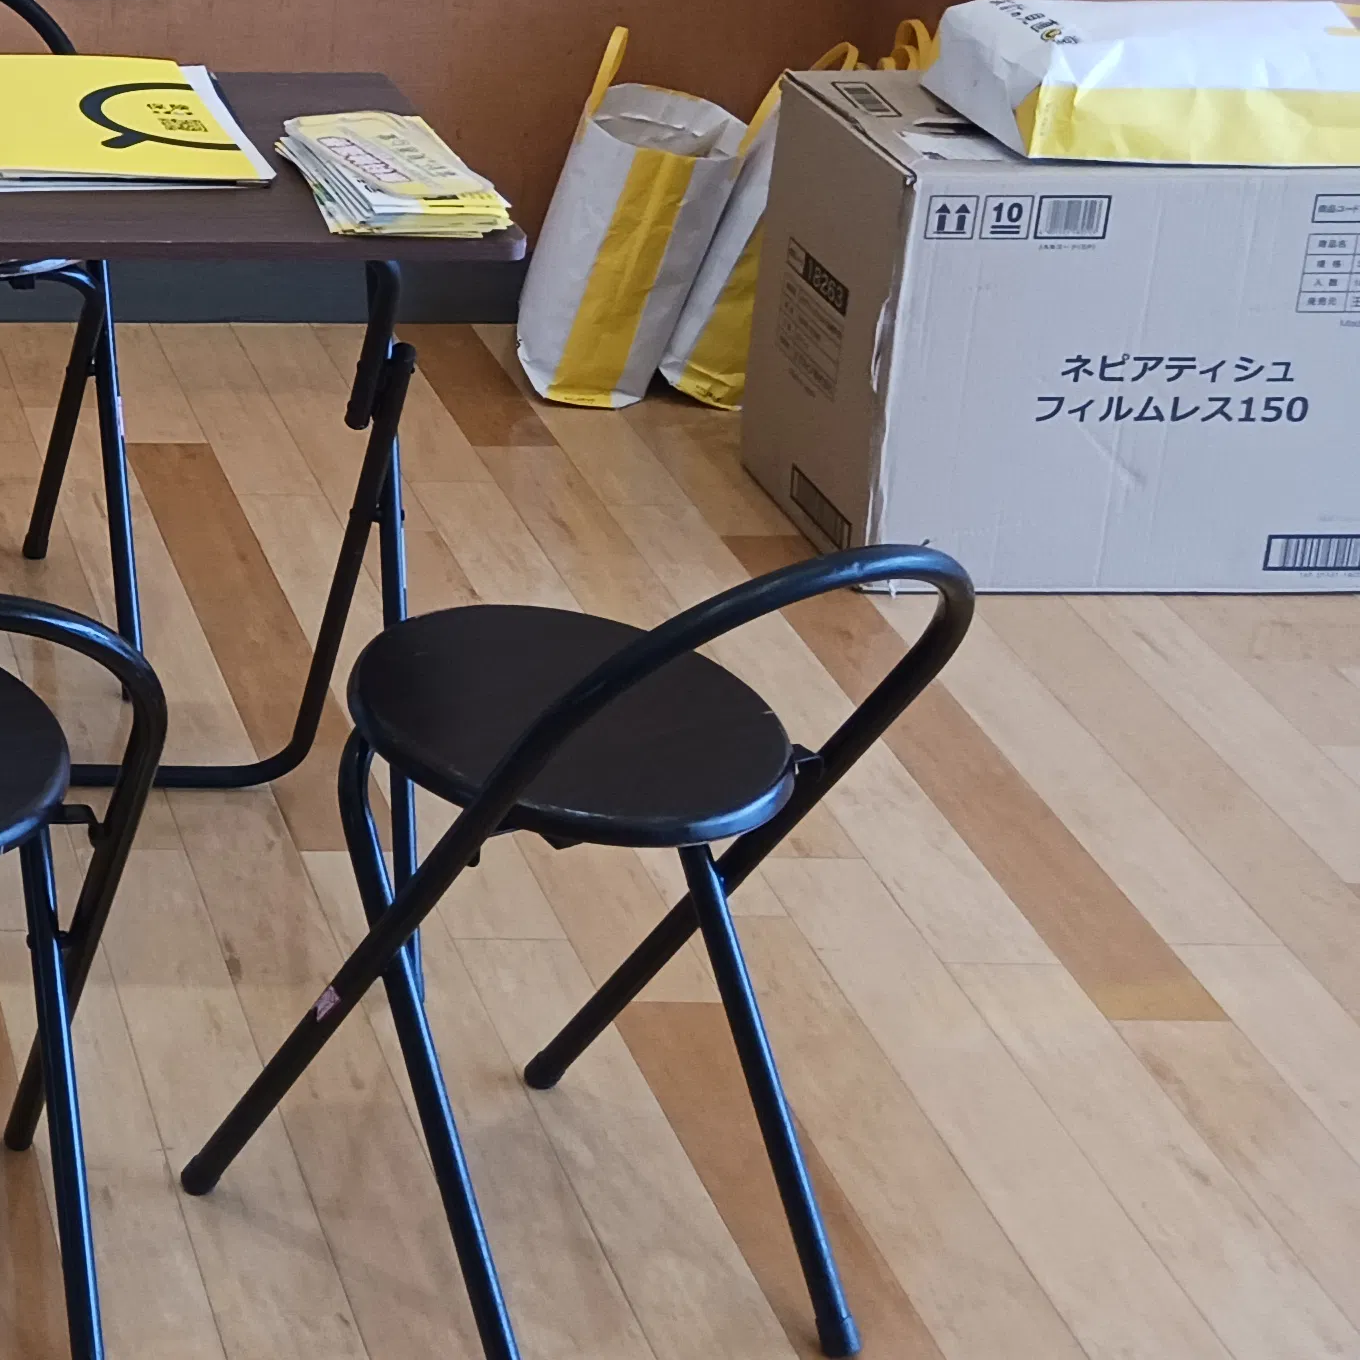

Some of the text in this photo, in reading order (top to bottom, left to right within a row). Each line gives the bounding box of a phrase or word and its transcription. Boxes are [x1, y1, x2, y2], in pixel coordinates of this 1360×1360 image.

[992, 202, 1024, 225] 10
[1061, 354, 1295, 384] ネピアティシュ
[1035, 395, 1310, 424] フィルムレス150
